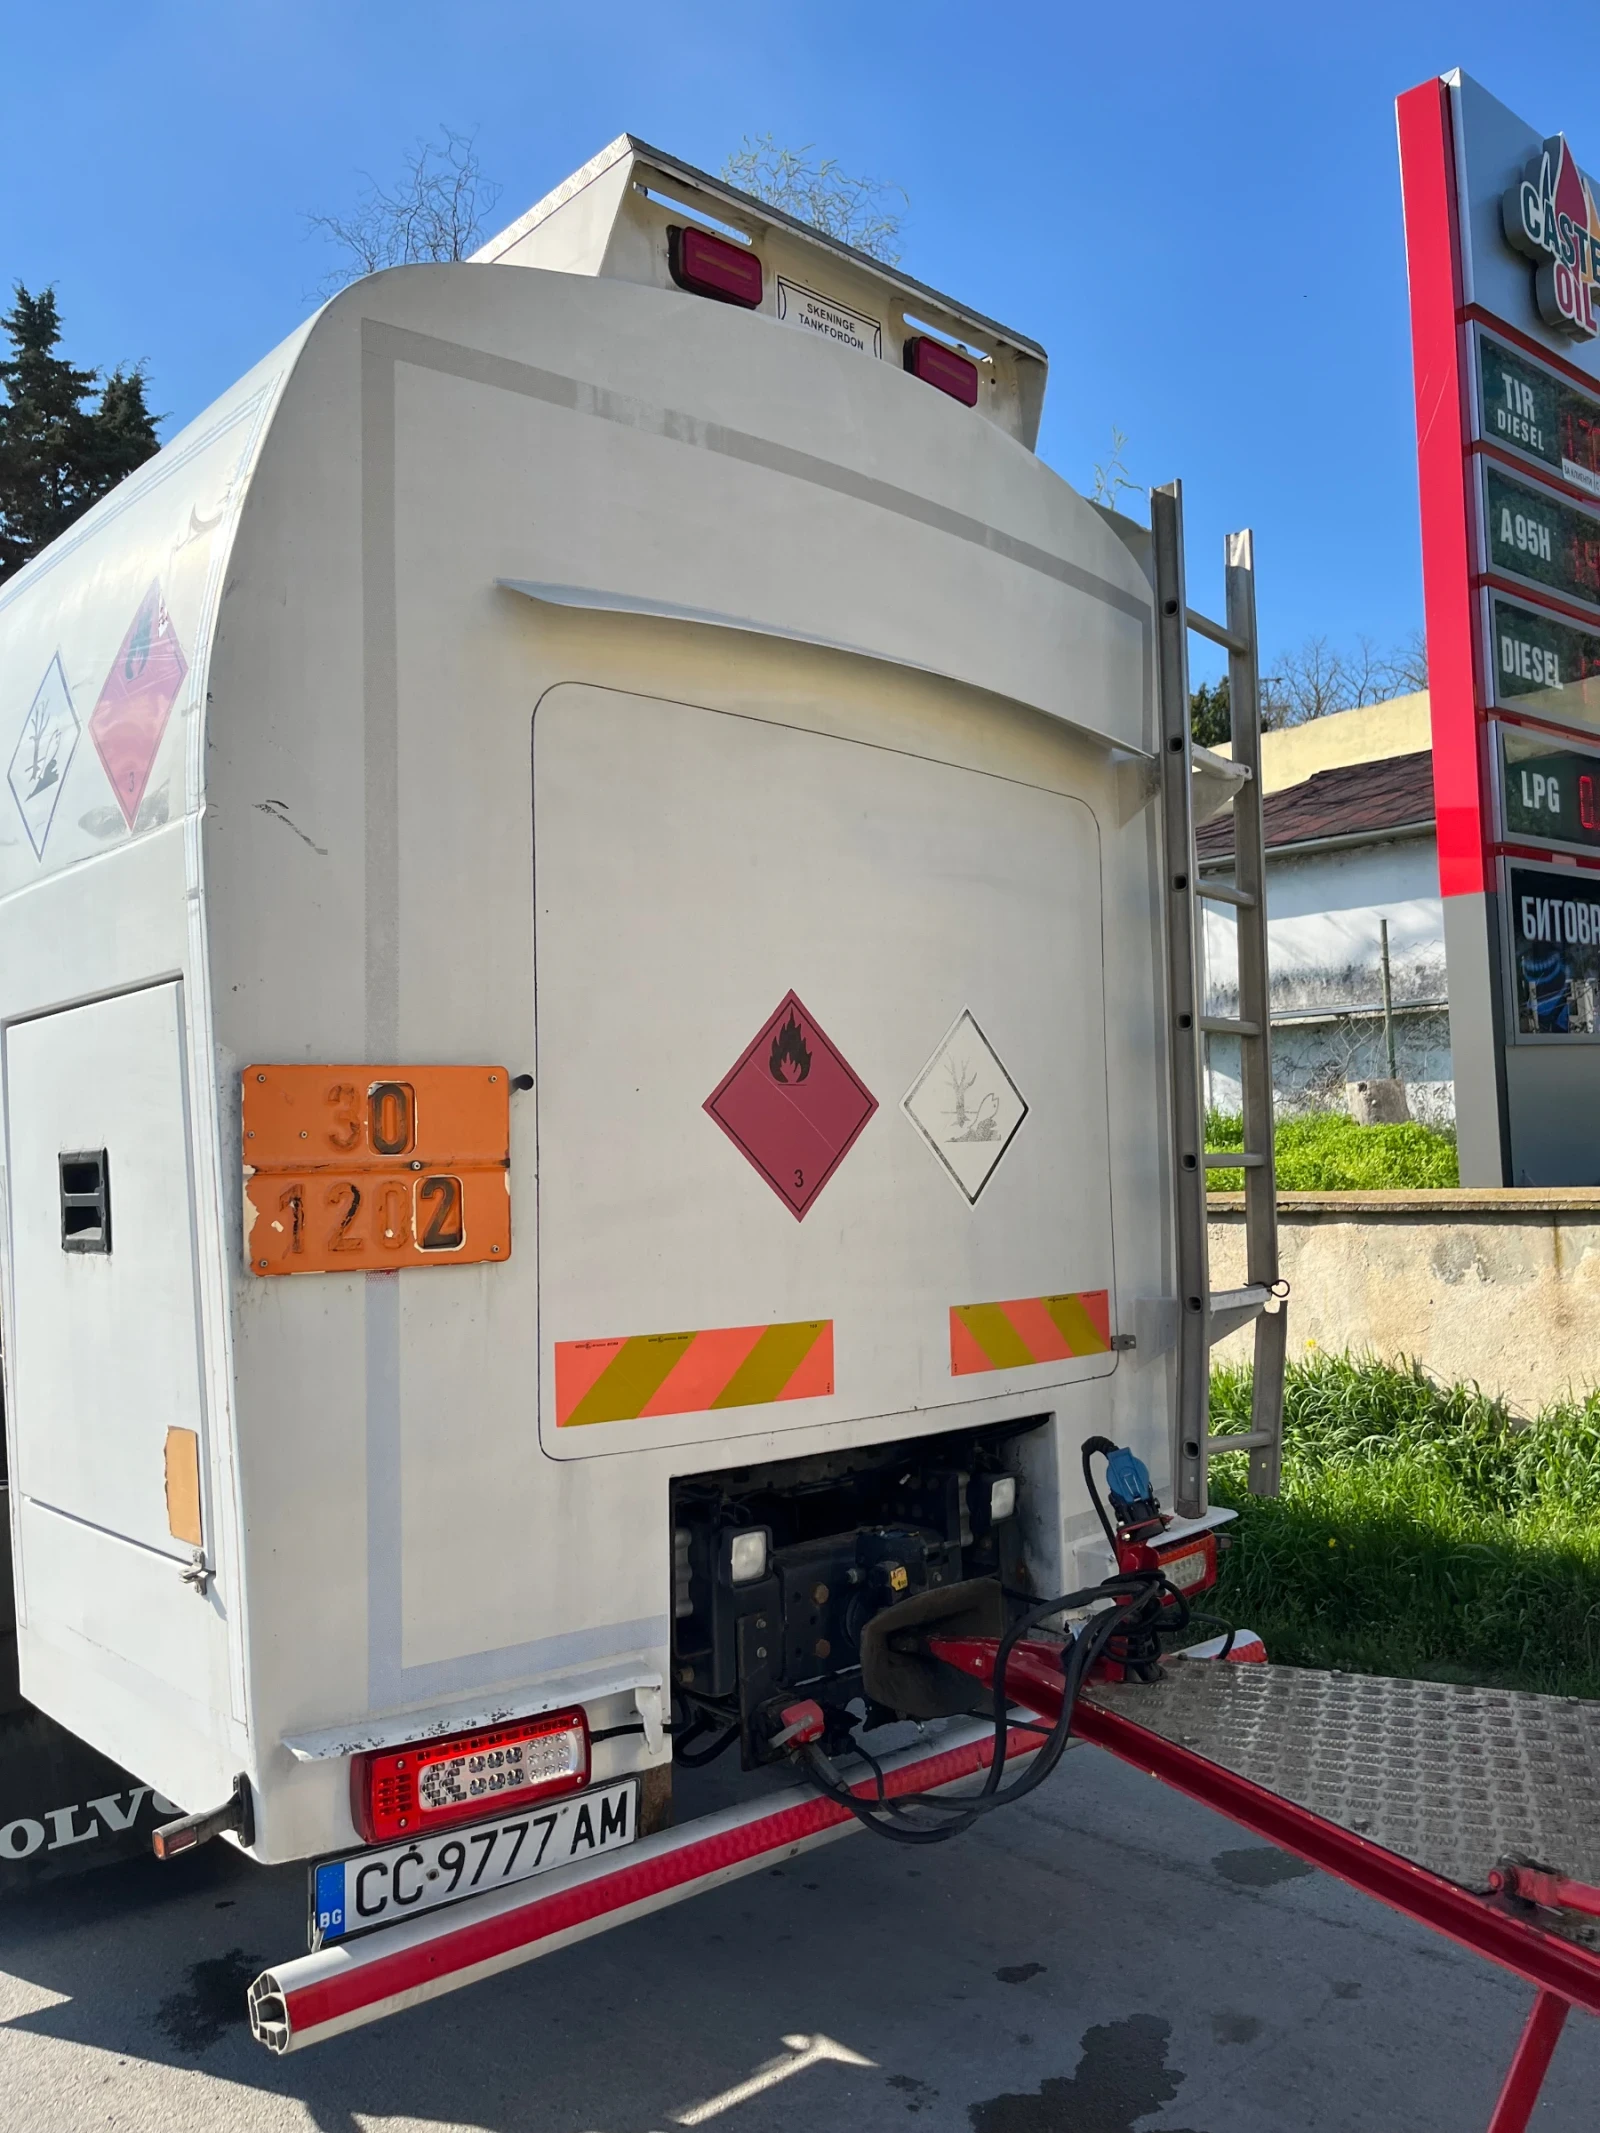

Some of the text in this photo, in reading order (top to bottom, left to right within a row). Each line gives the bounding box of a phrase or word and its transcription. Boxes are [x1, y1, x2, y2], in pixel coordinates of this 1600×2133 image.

[807, 303, 855, 333] SKENINGE
[1555, 263, 1598, 332] OIL
[798, 313, 864, 350] TANKFORDON
[1501, 372, 1536, 423] TIR
[1497, 407, 1545, 452] DIESEL
[1501, 634, 1565, 690] DIESEL
[129, 772, 136, 793] 3
[1521, 769, 1561, 815] LPG
[327, 1083, 408, 1155] 30
[794, 1169, 804, 1188] 3
[279, 1177, 459, 1255] 1202
[437, 1813, 559, 1894] 9777
[568, 1790, 628, 1856] AM
[319, 1909, 343, 1930] BG
